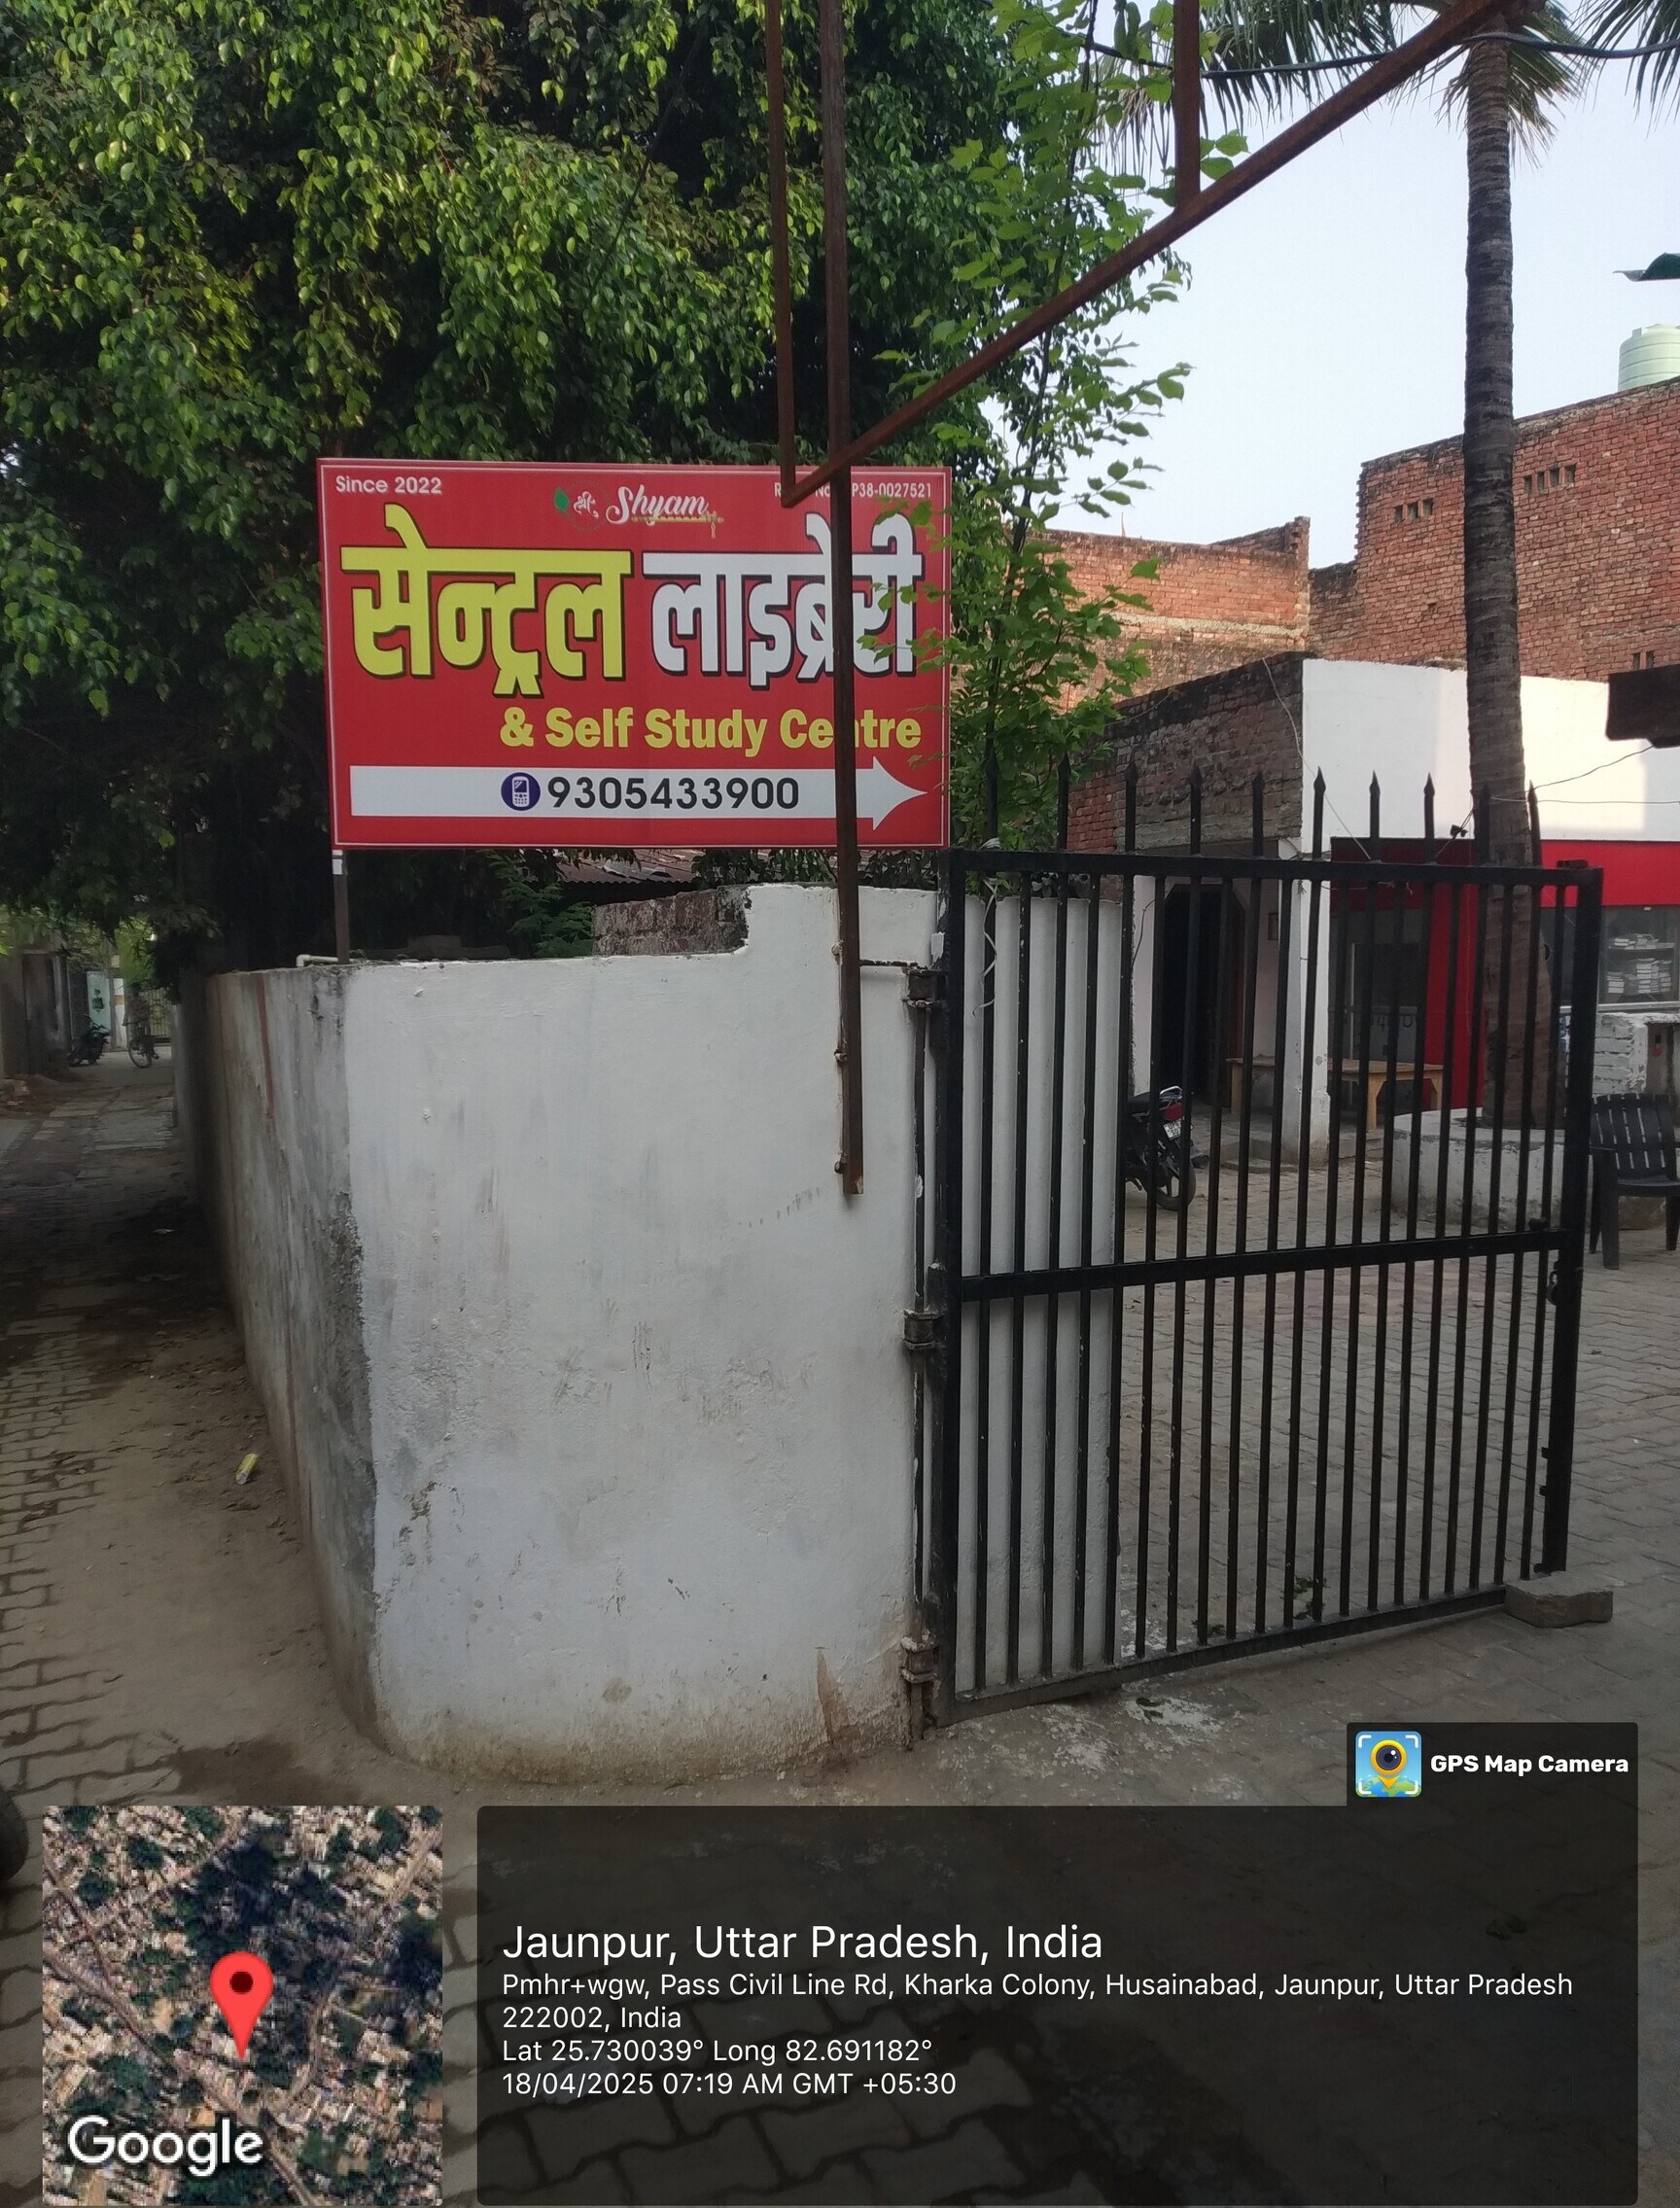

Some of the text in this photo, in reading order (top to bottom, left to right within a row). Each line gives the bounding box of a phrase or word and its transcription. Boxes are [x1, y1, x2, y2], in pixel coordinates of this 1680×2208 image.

[335, 474, 442, 495] Since 2022
[851, 481, 932, 499] P38-0027521
[605, 484, 710, 526] Shyam
[500, 706, 535, 749] &
[544, 706, 634, 749] Self
[644, 708, 768, 758] Study
[546, 776, 800, 810] 9305433900
